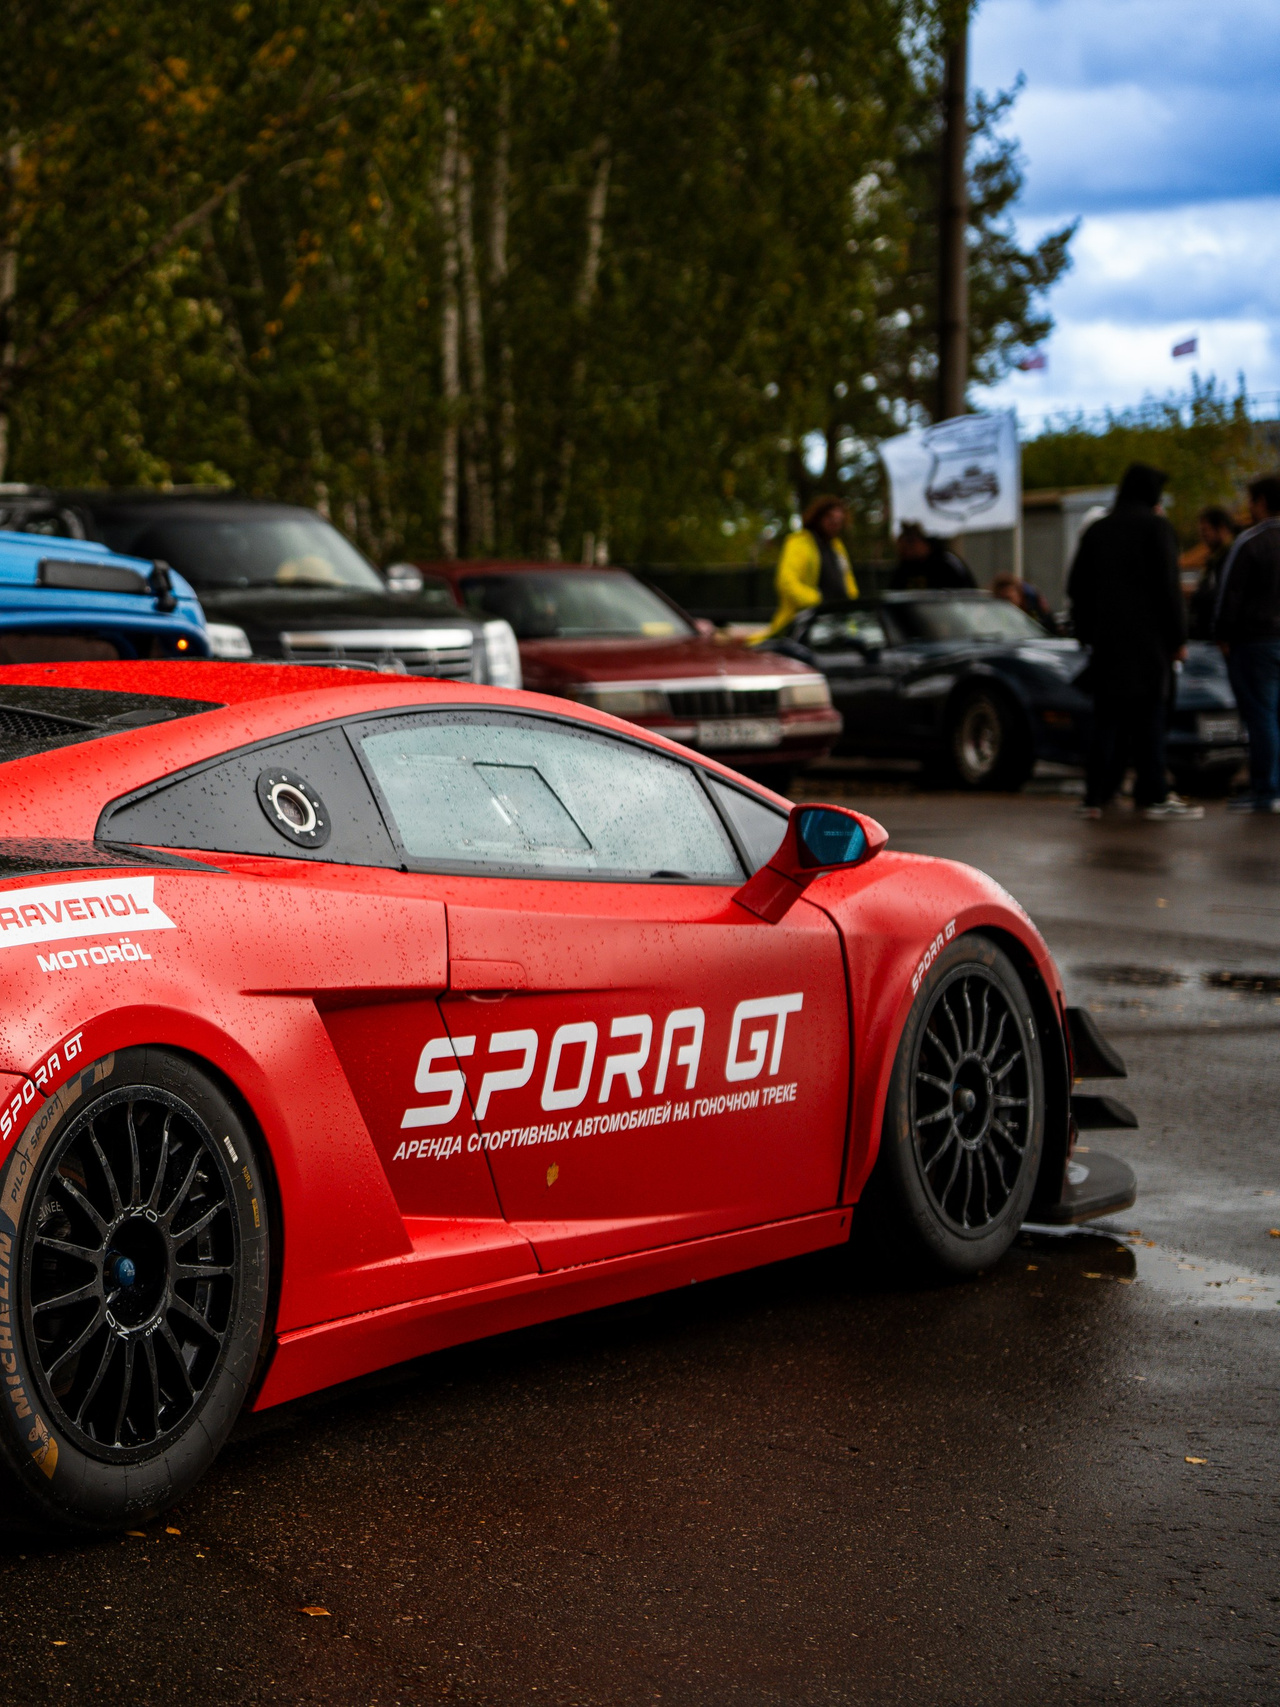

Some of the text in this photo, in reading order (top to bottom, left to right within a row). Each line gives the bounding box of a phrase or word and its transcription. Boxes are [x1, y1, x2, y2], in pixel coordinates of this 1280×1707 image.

[37, 937, 152, 973] MOTORÖL
[912, 918, 956, 995] SPORA GT
[0, 1032, 83, 1140] SPORA GT
[400, 1006, 705, 1129] SPORA
[725, 992, 804, 1083] GT
[11, 1097, 60, 1203] PILOT SPORT
[392, 1082, 798, 1161] АРЕНДА СПОРТИВНЫХ АВТОМОБИЛЕЙ НА ГОНОЧНОМ ТРЕКЕ
